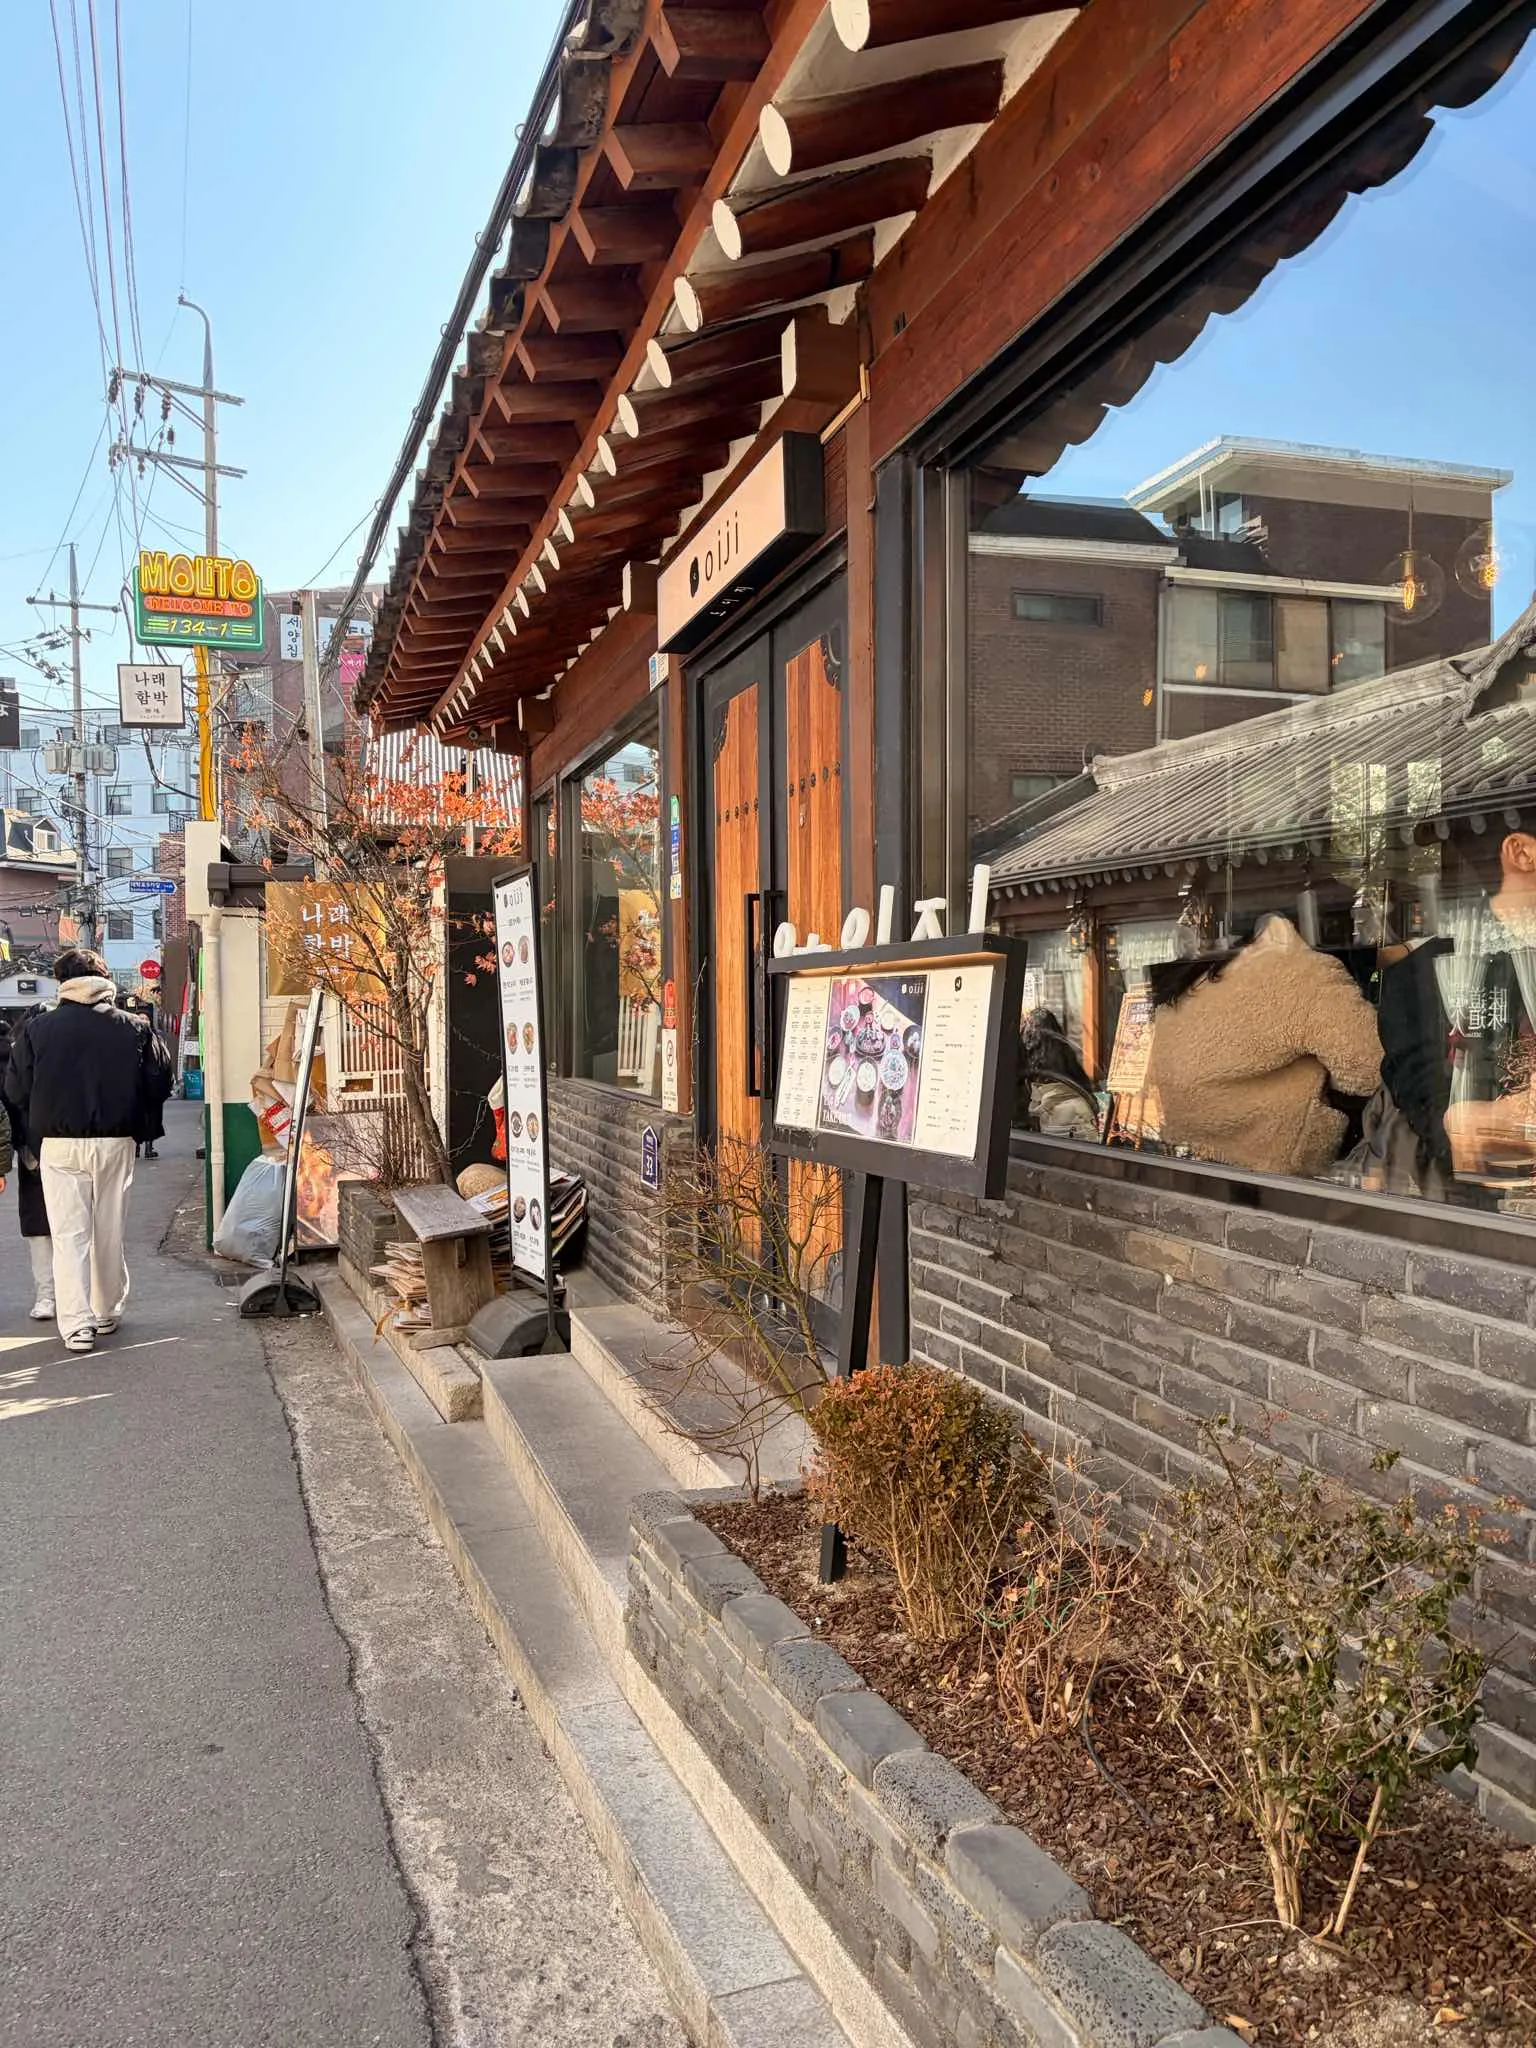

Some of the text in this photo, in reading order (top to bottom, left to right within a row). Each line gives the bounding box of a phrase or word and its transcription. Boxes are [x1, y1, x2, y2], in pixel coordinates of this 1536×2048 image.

[704, 510, 740, 582] oiji
[229, 600, 252, 617] TO
[168, 616, 228, 637] 134-1
[135, 671, 166, 688] 나래
[135, 690, 168, 707] 함박
